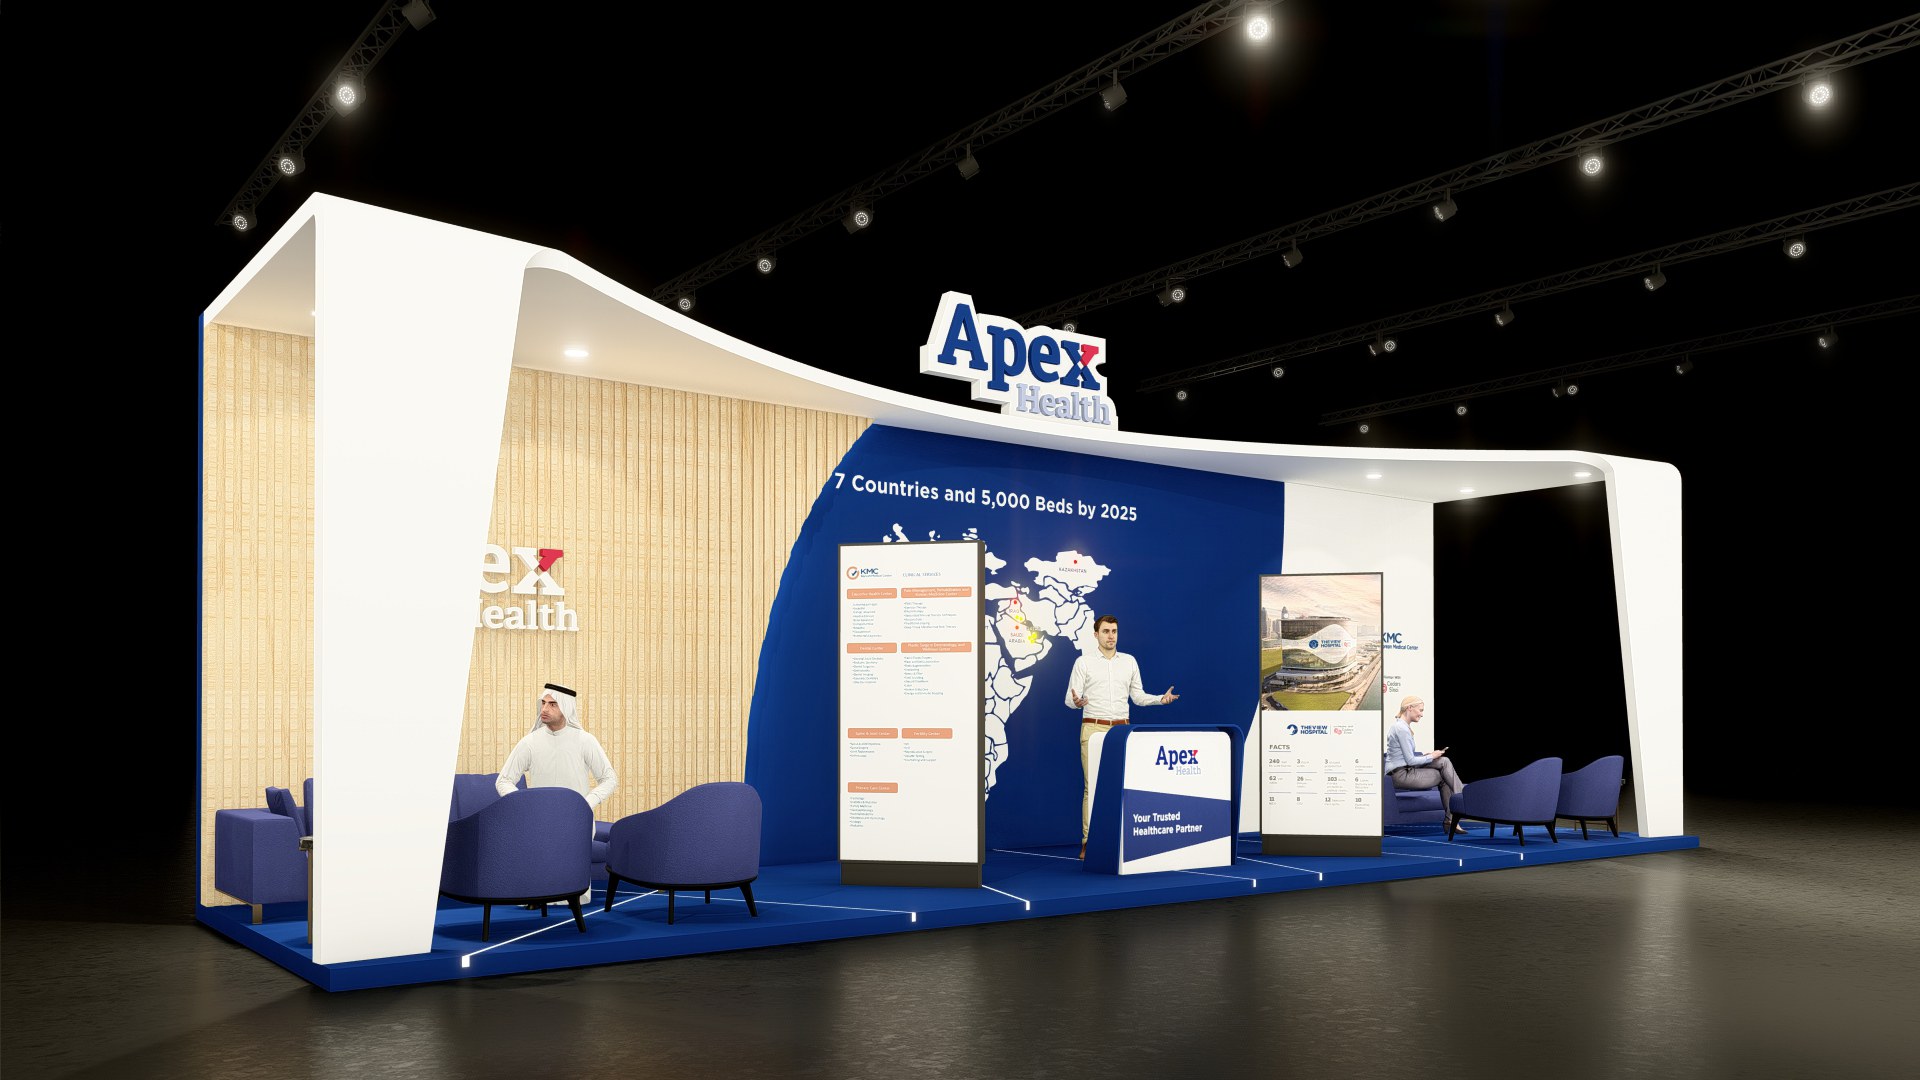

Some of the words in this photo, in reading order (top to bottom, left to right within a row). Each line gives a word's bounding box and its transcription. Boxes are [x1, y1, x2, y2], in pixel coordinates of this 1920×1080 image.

[937, 303, 1100, 392] Apex
[1016, 383, 1111, 425] Health
[834, 473, 846, 488] 7
[852, 474, 939, 500] Countries
[944, 488, 976, 504] and
[981, 490, 1030, 509] 5,000
[1036, 496, 1073, 515] Beds
[1078, 500, 1096, 519] by
[1100, 503, 1137, 521] 2025
[476, 598, 580, 631] ealth
[1156, 746, 1198, 770] Apex
[1176, 766, 1201, 775] Health
[1133, 814, 1151, 823] Your
[1153, 812, 1180, 822] Trusted
[1133, 826, 1173, 836] Healthcare
[1176, 824, 1202, 833] Partner
